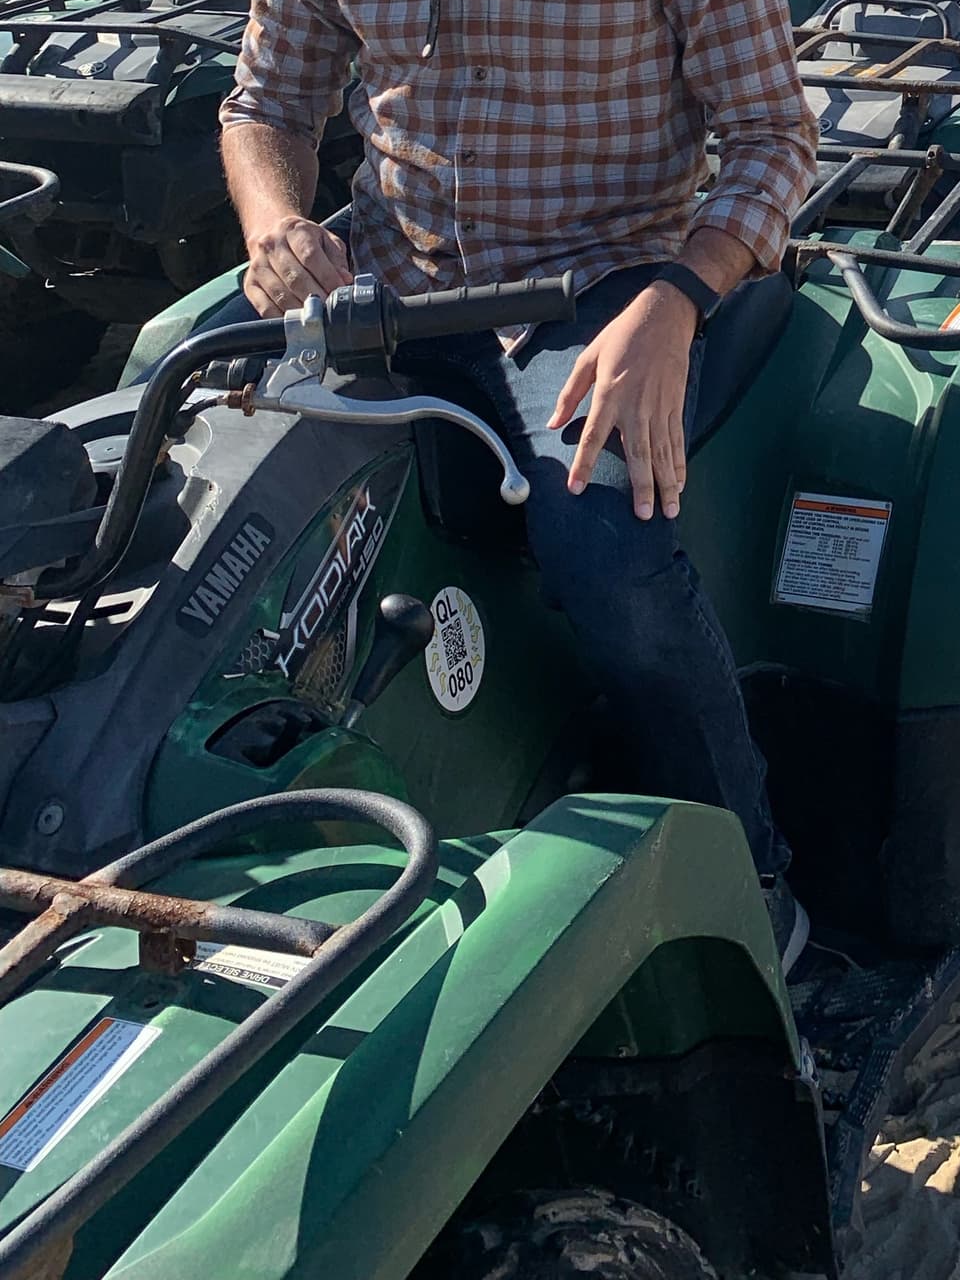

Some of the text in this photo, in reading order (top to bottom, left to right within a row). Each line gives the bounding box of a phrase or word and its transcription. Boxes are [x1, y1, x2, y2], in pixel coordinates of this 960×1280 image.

[180, 521, 272, 627] YAMAHA
[352, 515, 384, 582] 450
[273, 486, 377, 679] KODIAK
[435, 595, 458, 624] QL
[448, 661, 474, 698] 080
[241, 970, 271, 984] DRIVE
